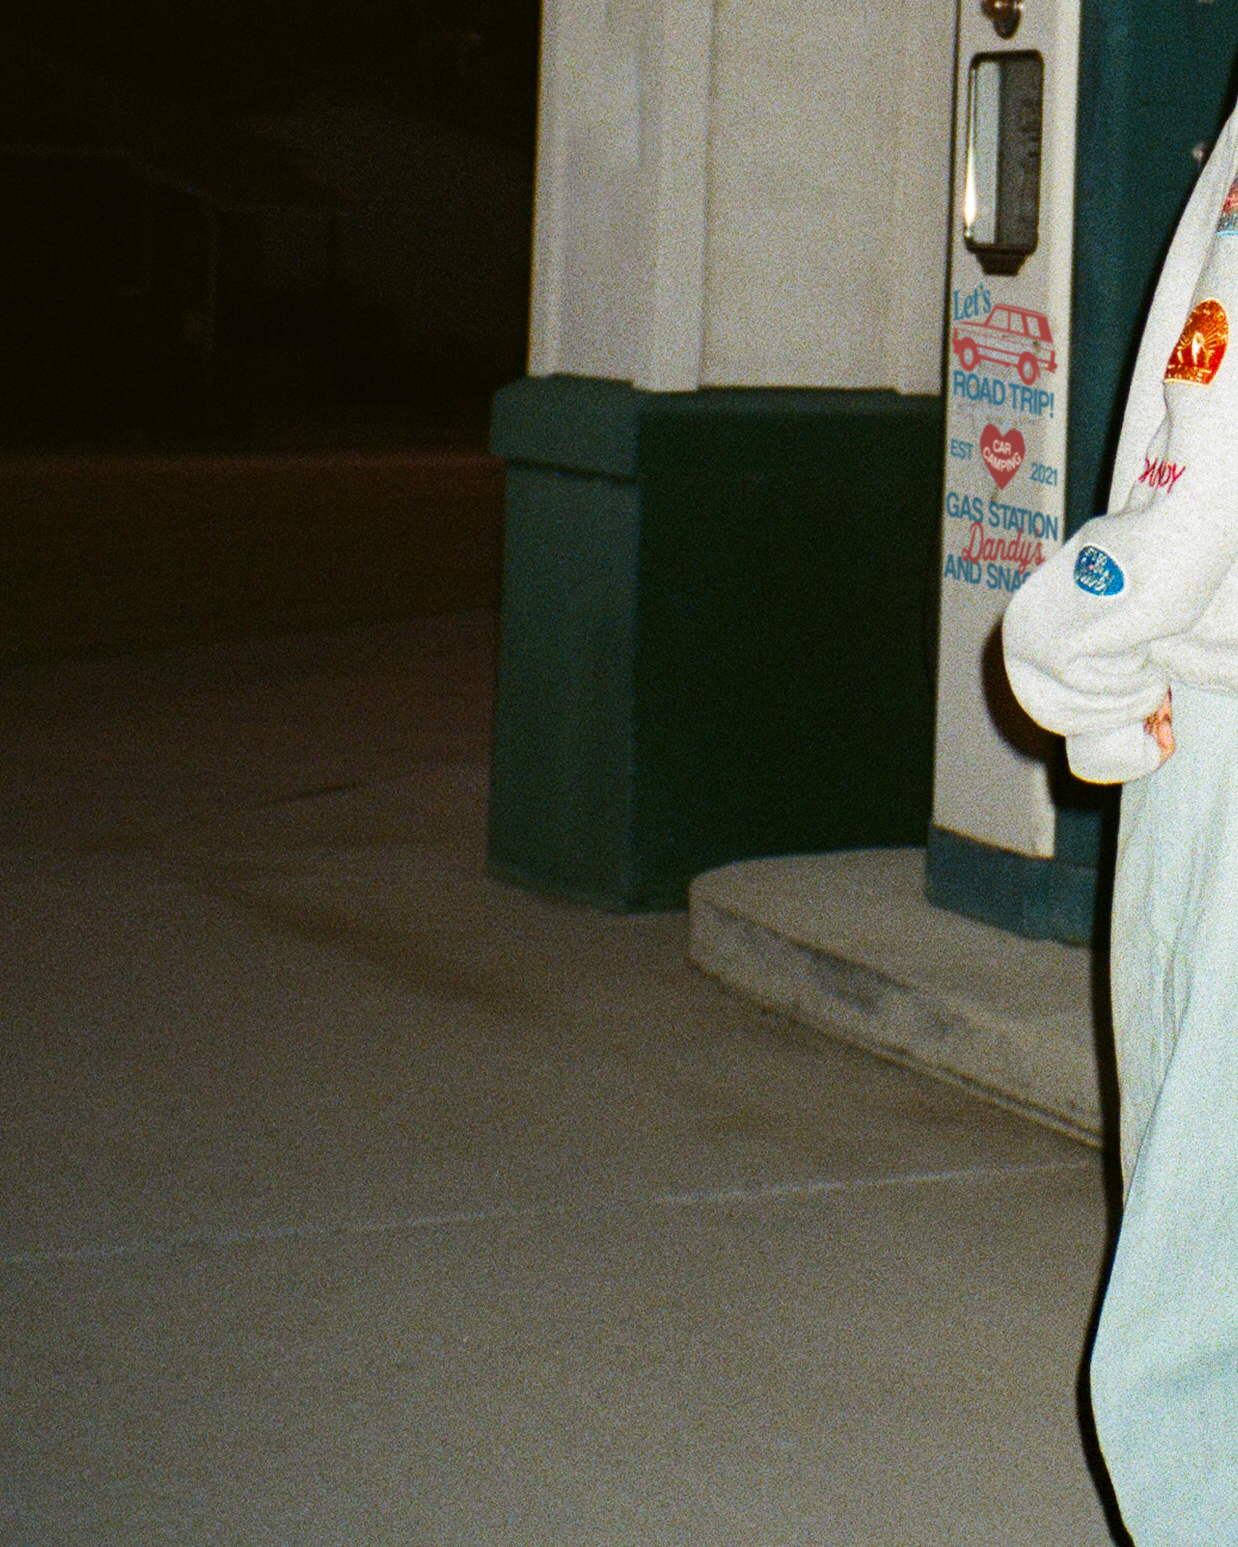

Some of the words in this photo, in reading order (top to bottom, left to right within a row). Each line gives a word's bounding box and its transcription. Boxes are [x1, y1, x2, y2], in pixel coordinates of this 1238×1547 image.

[952, 283, 992, 321] Let's
[952, 369, 1006, 406] ROAD
[1009, 382, 1055, 418] TRIP!
[949, 438, 974, 461] EST
[982, 446, 1022, 473] CAMPING
[992, 438, 1012, 456] CAR
[1030, 462, 1058, 487] 2021
[945, 491, 984, 524] GAS
[988, 500, 1059, 542] STATION
[961, 521, 1046, 575] Dandy's
[944, 553, 982, 585] AND
[986, 562, 1031, 593] SNA
